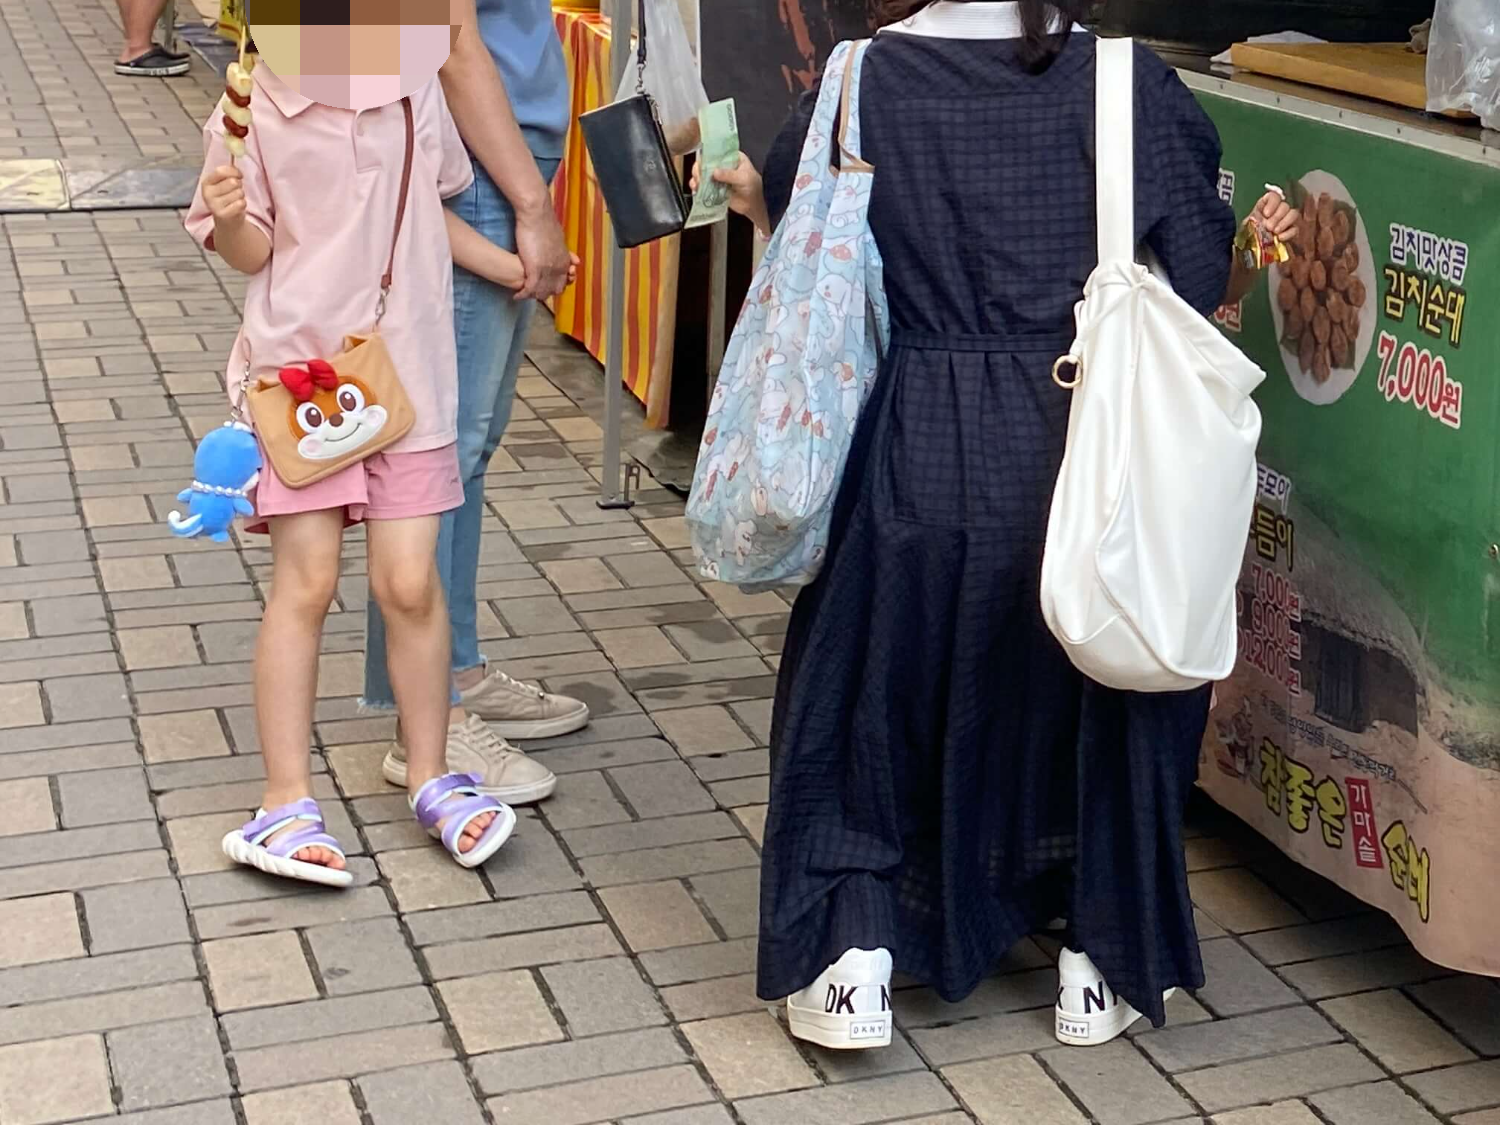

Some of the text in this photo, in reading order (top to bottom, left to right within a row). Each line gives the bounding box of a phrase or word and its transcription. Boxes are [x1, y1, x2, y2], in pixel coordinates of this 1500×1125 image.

[1389, 224, 1468, 284] 김치맛상큼
[1384, 268, 1466, 347] 김치순대
[1378, 332, 1462, 429] 7,000원
[1260, 736, 1347, 850] 참좋은
[1381, 820, 1430, 923] 순대
[853, 1025, 883, 1035] DKNY
